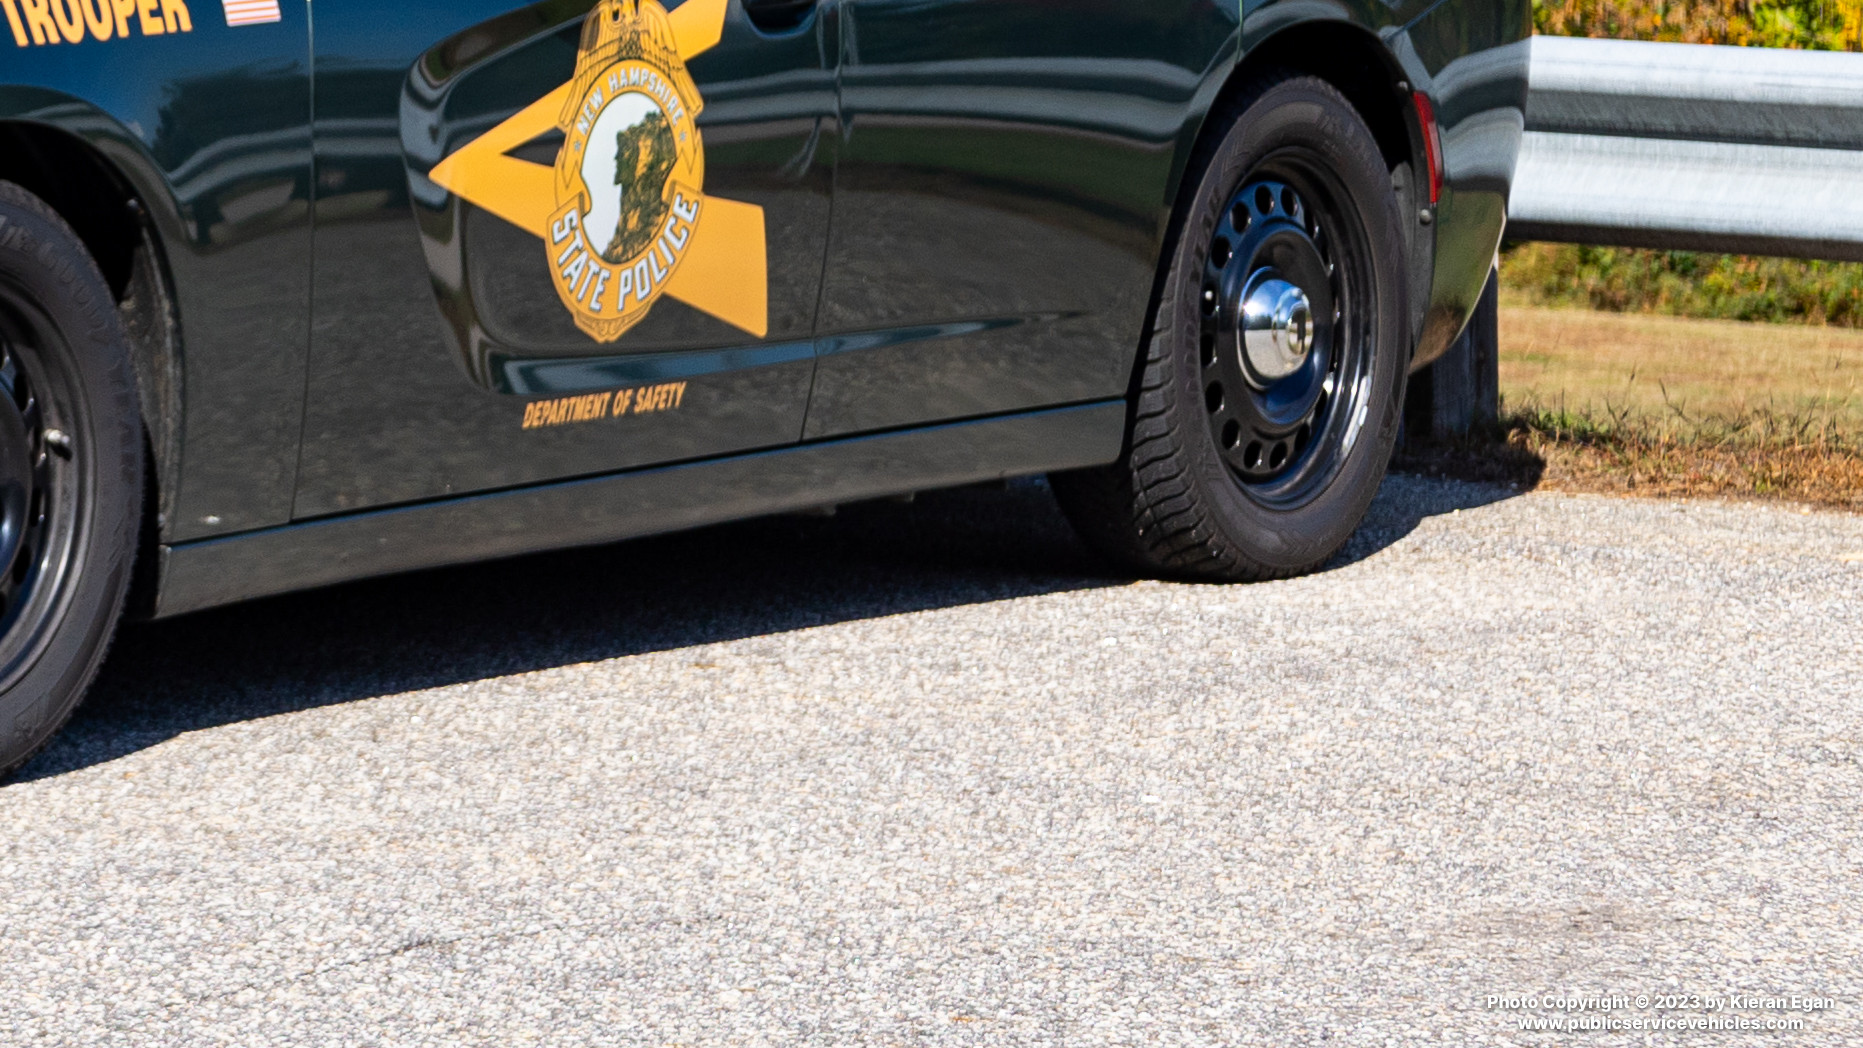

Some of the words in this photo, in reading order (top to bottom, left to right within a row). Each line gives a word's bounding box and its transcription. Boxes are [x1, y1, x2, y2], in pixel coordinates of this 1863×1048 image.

[576, 86, 604, 136] NEW
[608, 66, 685, 127] HAMPSHIRE
[551, 207, 612, 313] STATE
[617, 192, 699, 312] POLICE
[522, 391, 612, 430] DEPARTMENT
[612, 388, 634, 418] OF
[633, 381, 687, 414] SAFETY
